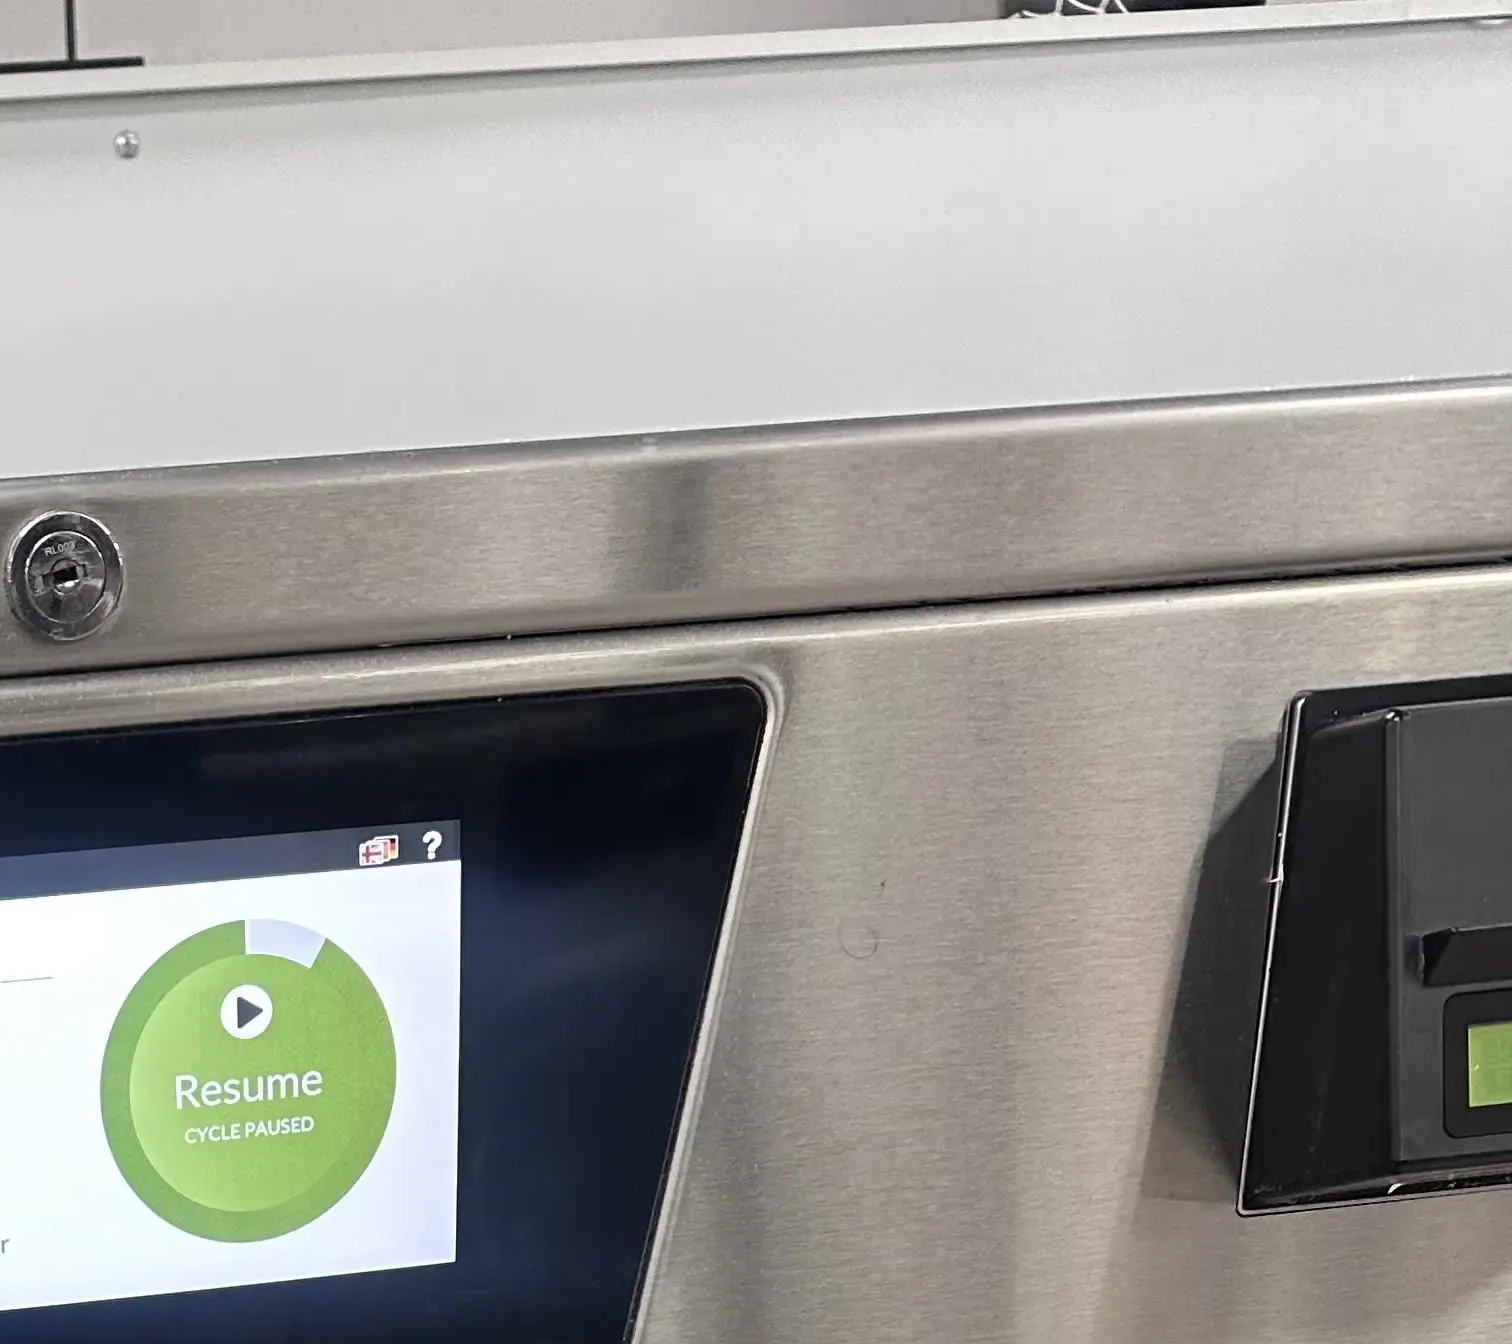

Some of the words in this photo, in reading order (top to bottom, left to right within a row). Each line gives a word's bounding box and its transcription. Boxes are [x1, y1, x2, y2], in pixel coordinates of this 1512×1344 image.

[174, 1067, 324, 1110] Resume
[184, 1121, 240, 1145] CYCLE
[245, 1115, 315, 1139] PAUSED
